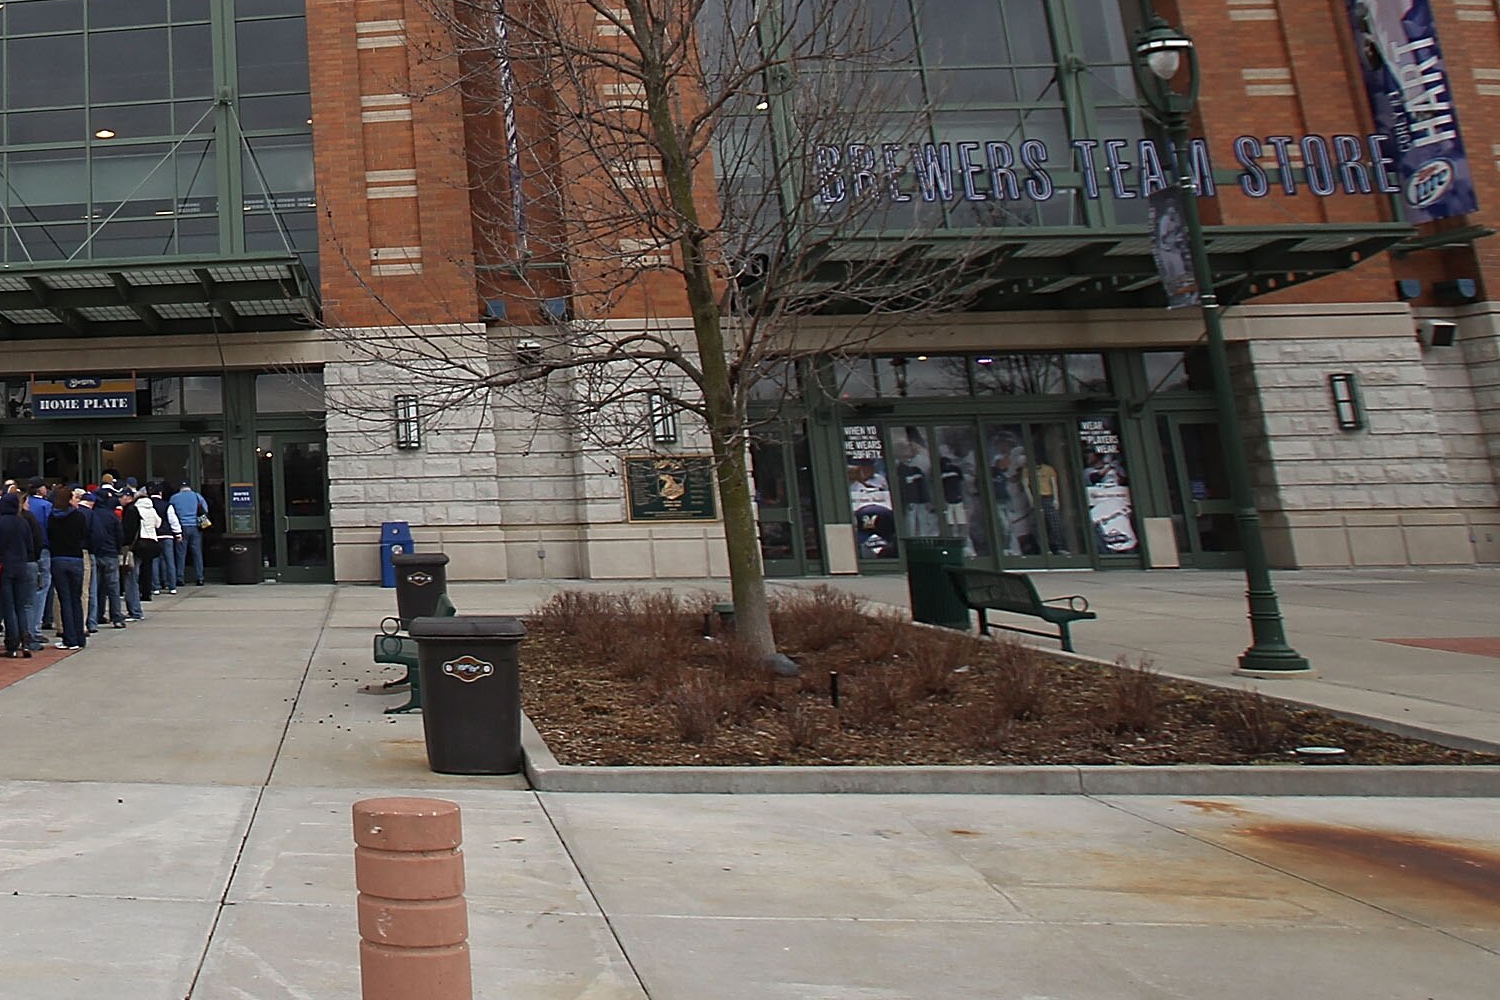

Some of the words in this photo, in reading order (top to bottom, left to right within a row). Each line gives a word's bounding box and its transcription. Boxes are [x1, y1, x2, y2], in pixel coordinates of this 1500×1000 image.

[1391, 36, 1457, 148] HART
[816, 139, 1054, 203] BREWERS
[1071, 138, 1215, 199] TEAM
[1235, 133, 1402, 198] STORE
[40, 400, 79, 410] HOME
[84, 398, 128, 409] PLATE
[844, 426, 866, 435] WHEN
[856, 440, 882, 449] WEARS
